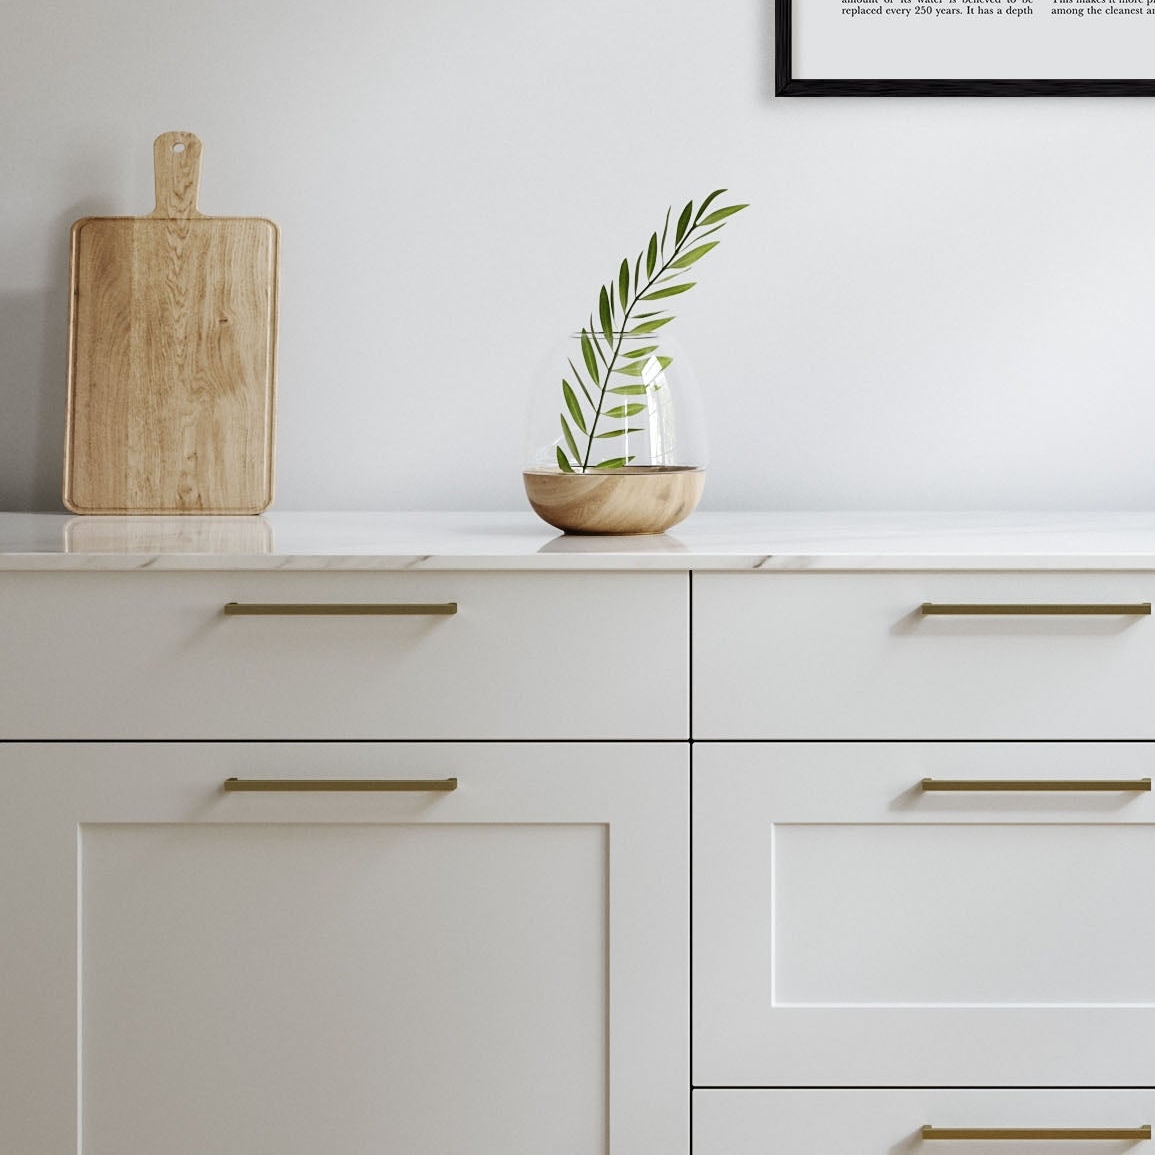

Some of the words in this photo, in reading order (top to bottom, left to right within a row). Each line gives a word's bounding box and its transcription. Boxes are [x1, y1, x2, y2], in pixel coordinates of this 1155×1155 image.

[1051, 8, 1084, 18] among
[1087, 6, 1102, 15] the
[1105, 6, 1143, 15] cleanest
